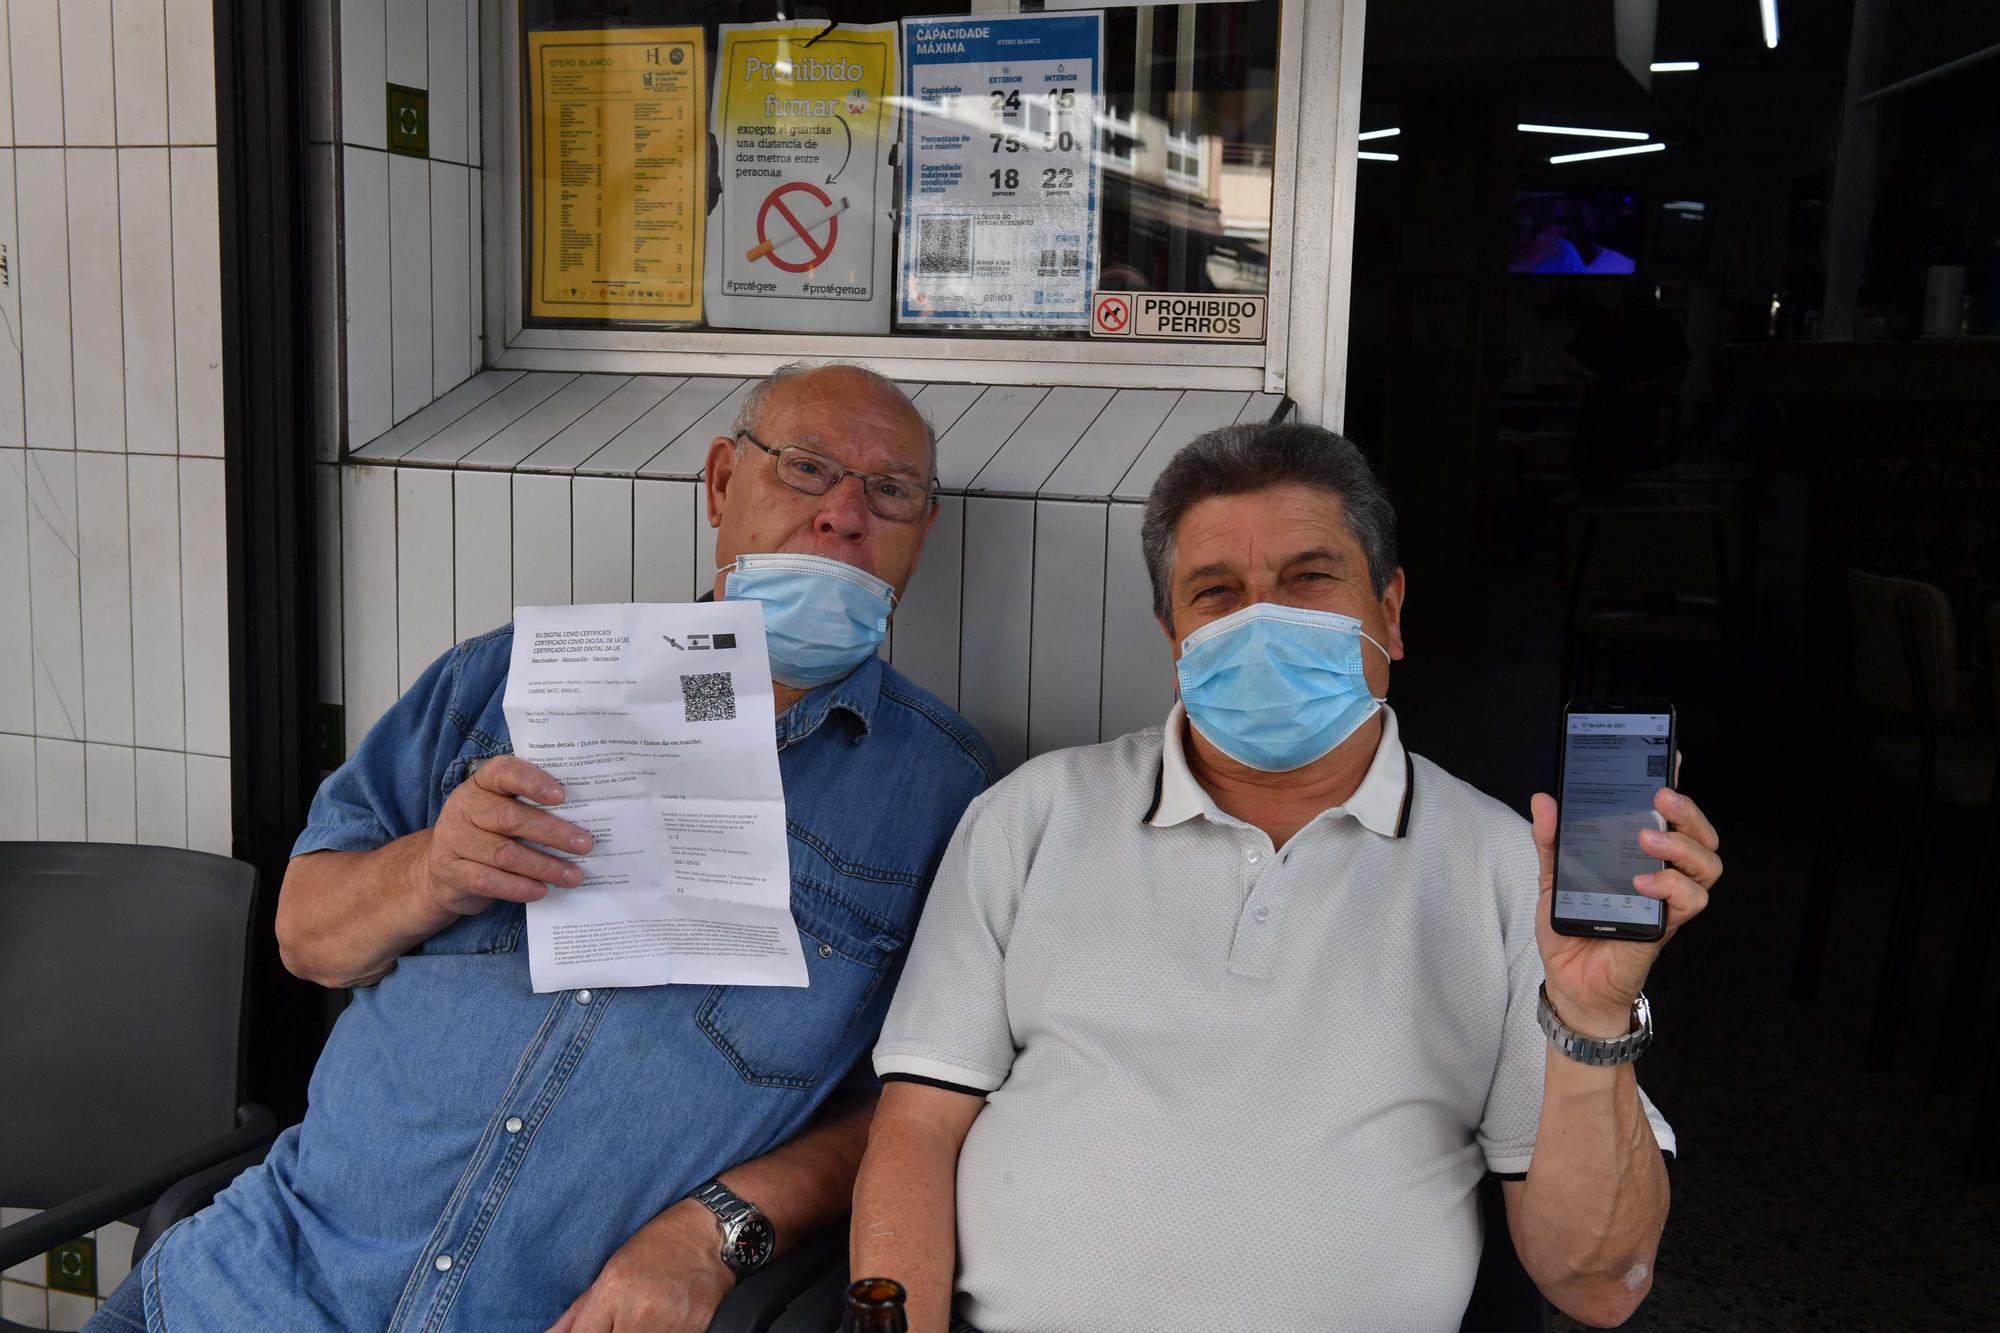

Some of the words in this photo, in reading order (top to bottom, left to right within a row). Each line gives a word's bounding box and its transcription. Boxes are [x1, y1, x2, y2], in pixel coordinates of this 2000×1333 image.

[916, 28, 990, 40] CAPACIDADE
[916, 42, 965, 54] MÁXIMA
[745, 57, 863, 81] Prohibido
[989, 76, 1022, 84] EXTERIOR
[921, 86, 961, 94] Capacidade
[764, 94, 839, 117] fumar
[990, 90, 1021, 110] 24
[737, 126, 775, 136] excepto
[790, 125, 832, 136] guardas
[737, 140, 754, 148] una
[758, 139, 801, 148] distancia
[805, 140, 818, 148] de
[736, 153, 753, 162] dos
[757, 154, 791, 163] metros
[795, 155, 820, 163] entre
[736, 168, 782, 178] personas
[921, 164, 961, 173] Capacidade
[990, 168, 1019, 189] 18
[1042, 168, 1073, 189] 22
[726, 280, 777, 292] #protégete
[802, 283, 866, 296] #protégenos
[1145, 300, 1256, 318] PROHIBIDO
[1158, 317, 1241, 334] PERROS
